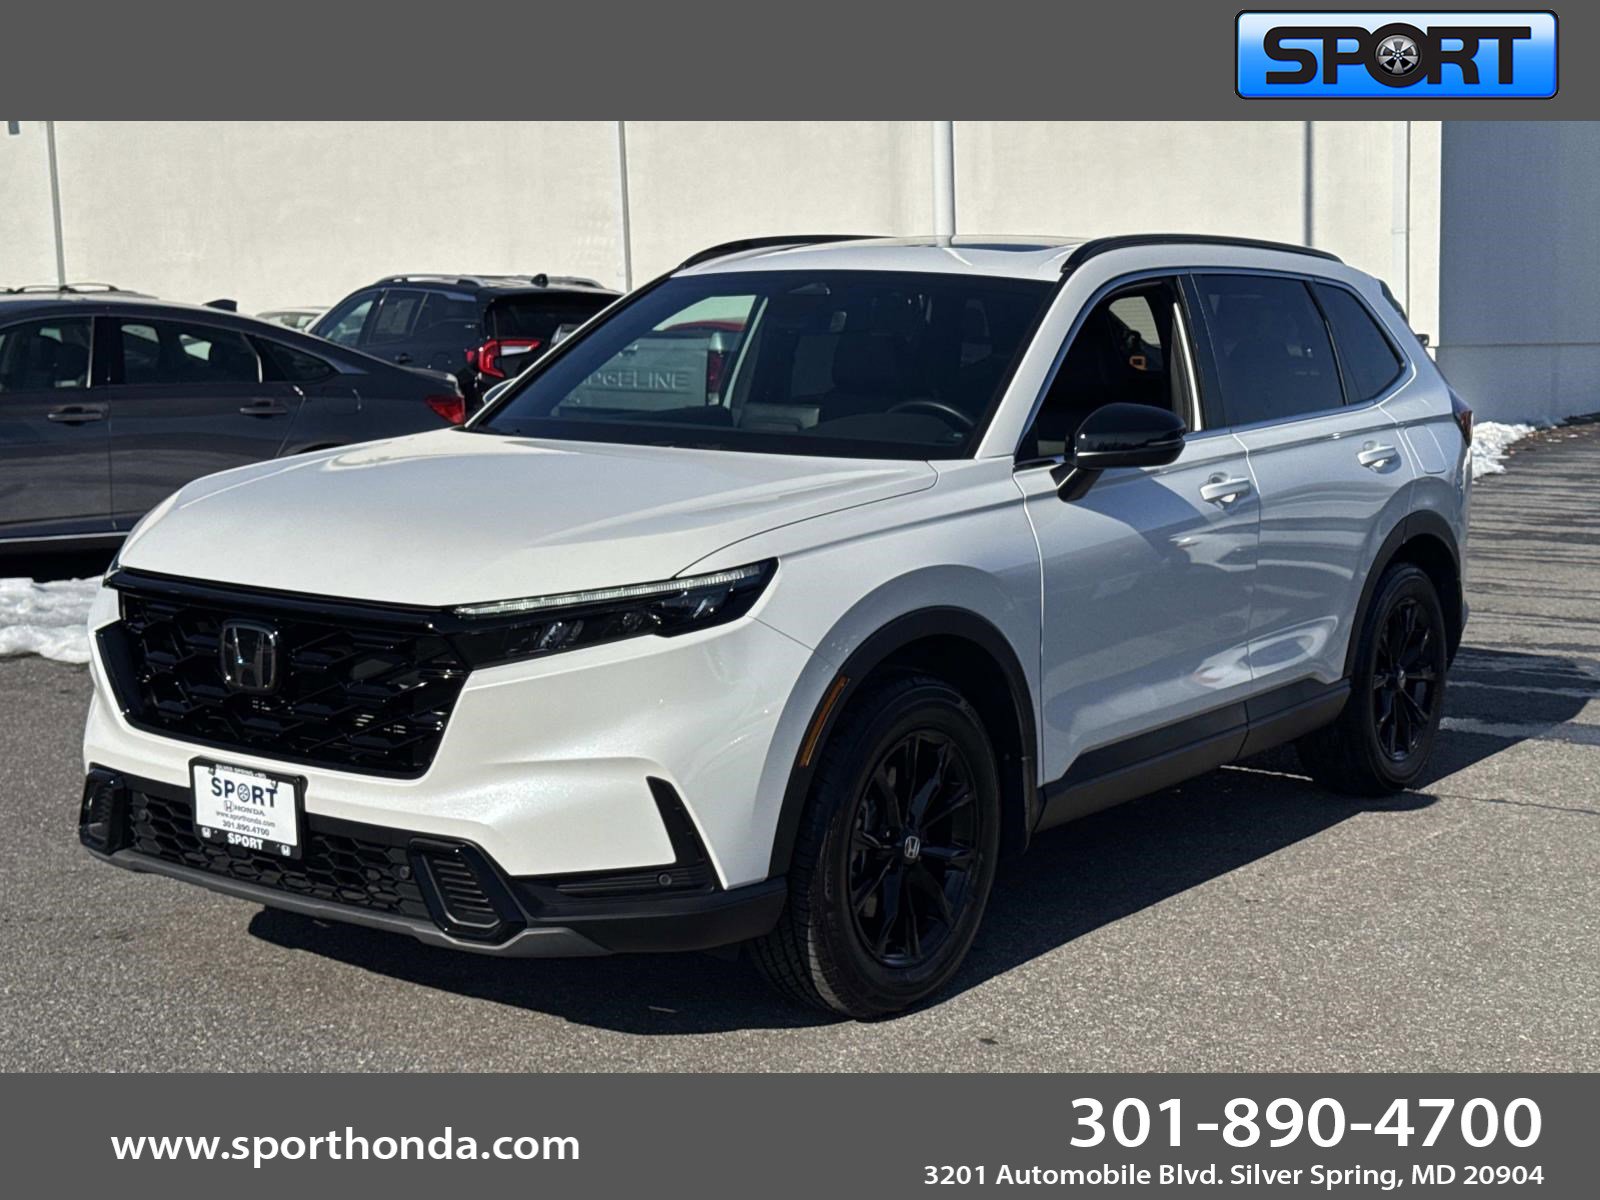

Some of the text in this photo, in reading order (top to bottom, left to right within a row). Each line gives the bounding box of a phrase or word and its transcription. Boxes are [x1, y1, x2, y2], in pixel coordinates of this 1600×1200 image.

[583, 369, 690, 390] DGELINE
[211, 777, 277, 807] SPORT
[234, 804, 266, 816] HONDA
[227, 832, 264, 850] SPORT
